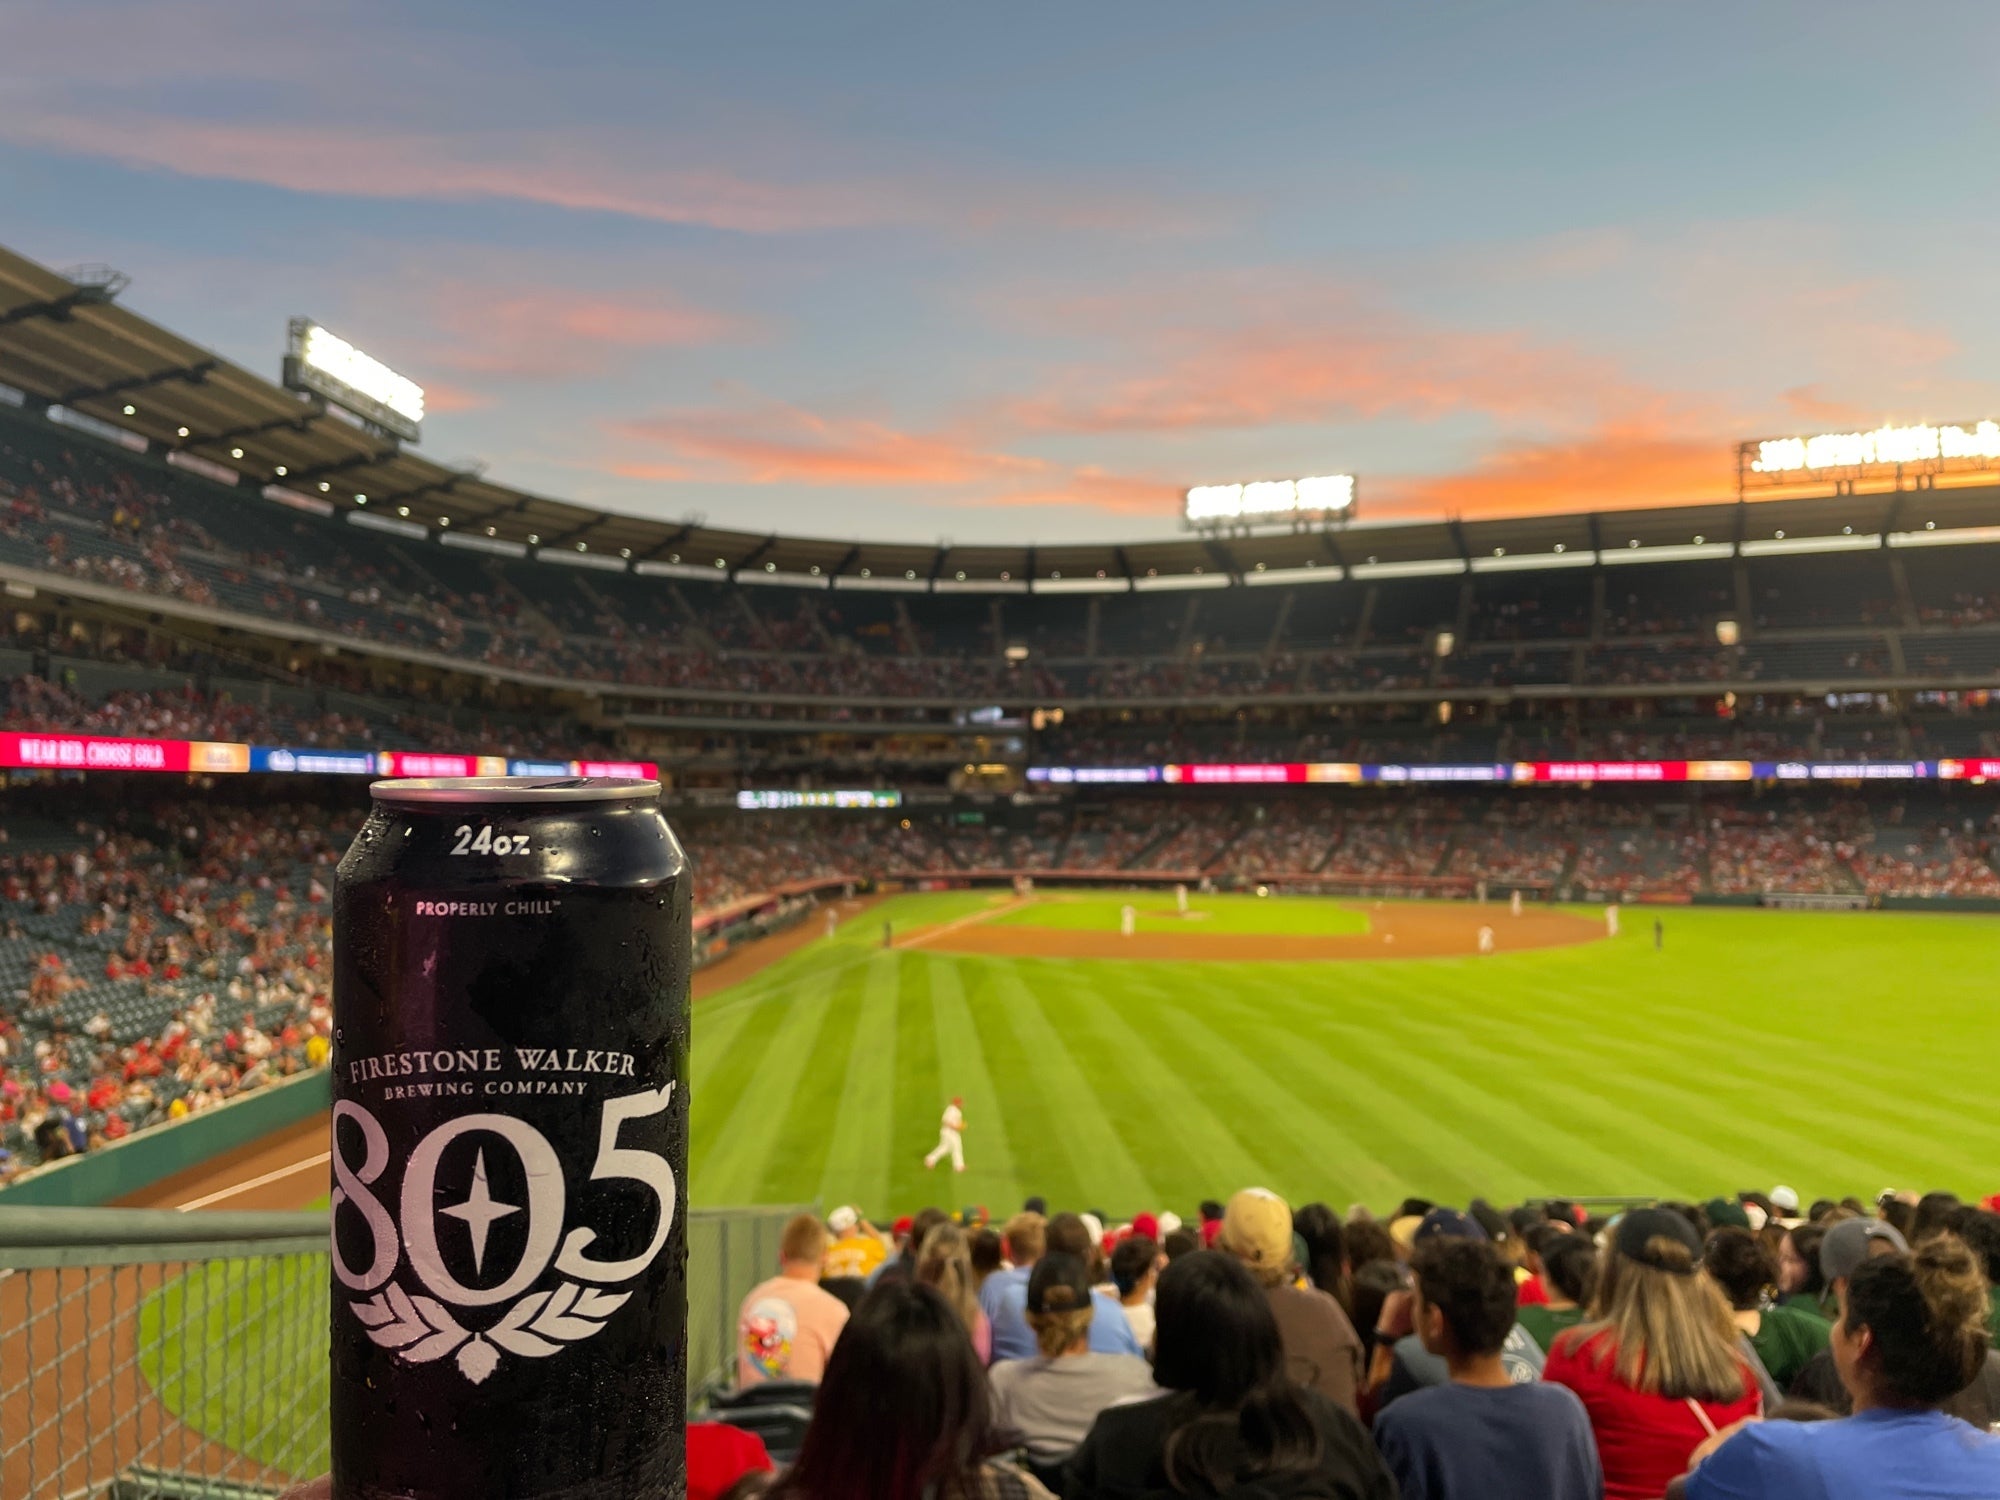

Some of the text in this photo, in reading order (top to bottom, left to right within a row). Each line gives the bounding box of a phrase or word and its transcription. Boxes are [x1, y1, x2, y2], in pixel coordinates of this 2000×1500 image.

[449, 824, 531, 856] 24oz
[416, 901, 498, 917] PROPERLY
[350, 1048, 636, 1084] FIRESTONE WALKER
[384, 1080, 589, 1101] BREWING COMPANY
[331, 1080, 677, 1307] 805
